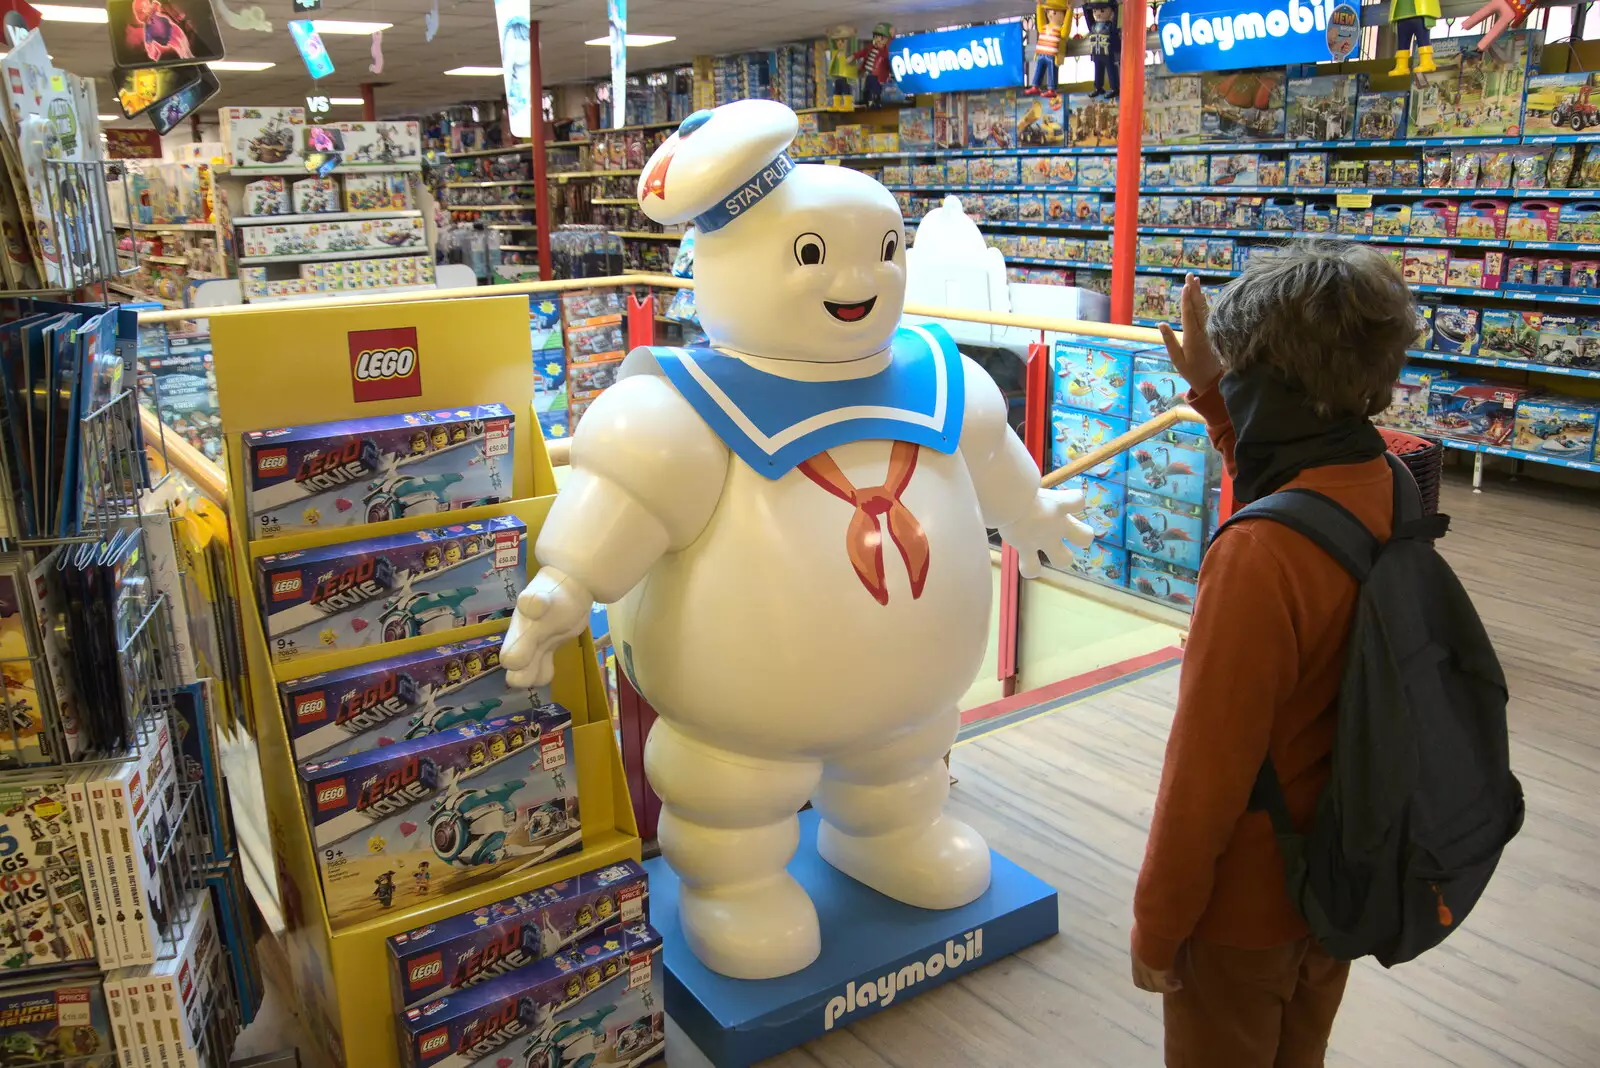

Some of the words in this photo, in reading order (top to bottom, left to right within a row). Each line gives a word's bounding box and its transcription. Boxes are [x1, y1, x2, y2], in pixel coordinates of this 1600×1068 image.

[1333, 12, 1356, 25] NEW
[1161, 0, 1335, 56] playmobil
[891, 37, 1004, 82] playmobil
[306, 96, 330, 113] VS
[725, 178, 765, 216] STAY
[1542, 316, 1575, 326] playmobil
[355, 348, 415, 381] LEGO
[258, 453, 288, 470] LEGO
[295, 438, 362, 483] LEGO
[303, 449, 321, 463] THE
[261, 515, 279, 526] 9+
[310, 557, 374, 604] LEGO
[316, 570, 334, 584] THE
[273, 578, 301, 594] LEGO
[277, 638, 295, 649] 9+
[334, 672, 397, 725] LEGO
[340, 688, 357, 704] THE
[297, 699, 325, 716] LEGO
[545, 753, 565, 765] €50.00
[356, 755, 418, 811] LEGO
[361, 774, 378, 790] THE
[317, 786, 346, 803] LEGO
[325, 849, 344, 861] 9+
[621, 890, 641, 901] PRICE
[451, 924, 521, 988] LEGO
[457, 946, 476, 963] THE
[410, 961, 441, 982] LEGO
[824, 928, 983, 1031] playmobil
[58, 993, 89, 1002] PRICE
[456, 998, 518, 1055] LEGO
[463, 1019, 480, 1035] THE
[422, 1033, 449, 1052] LEGO
